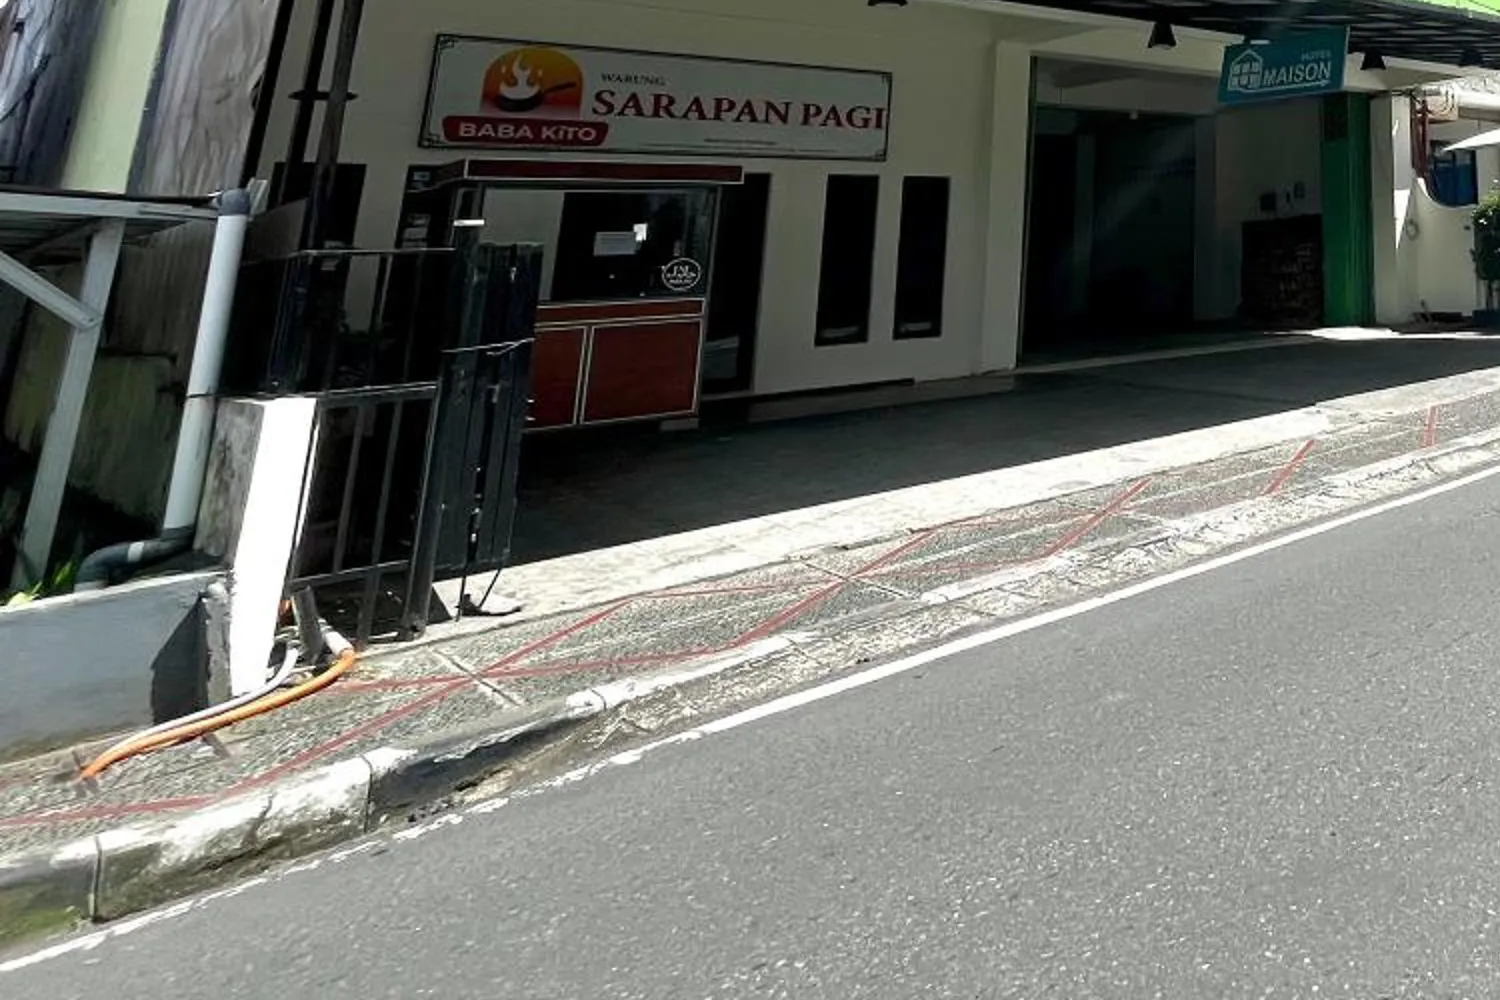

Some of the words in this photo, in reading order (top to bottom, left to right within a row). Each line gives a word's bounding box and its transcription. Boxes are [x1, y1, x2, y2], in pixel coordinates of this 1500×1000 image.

[601, 72, 666, 86] WARUNG
[1263, 60, 1332, 87] MAISON
[591, 89, 792, 126] SARAPAN
[801, 103, 887, 130] PAGI
[458, 121, 534, 140] BABA
